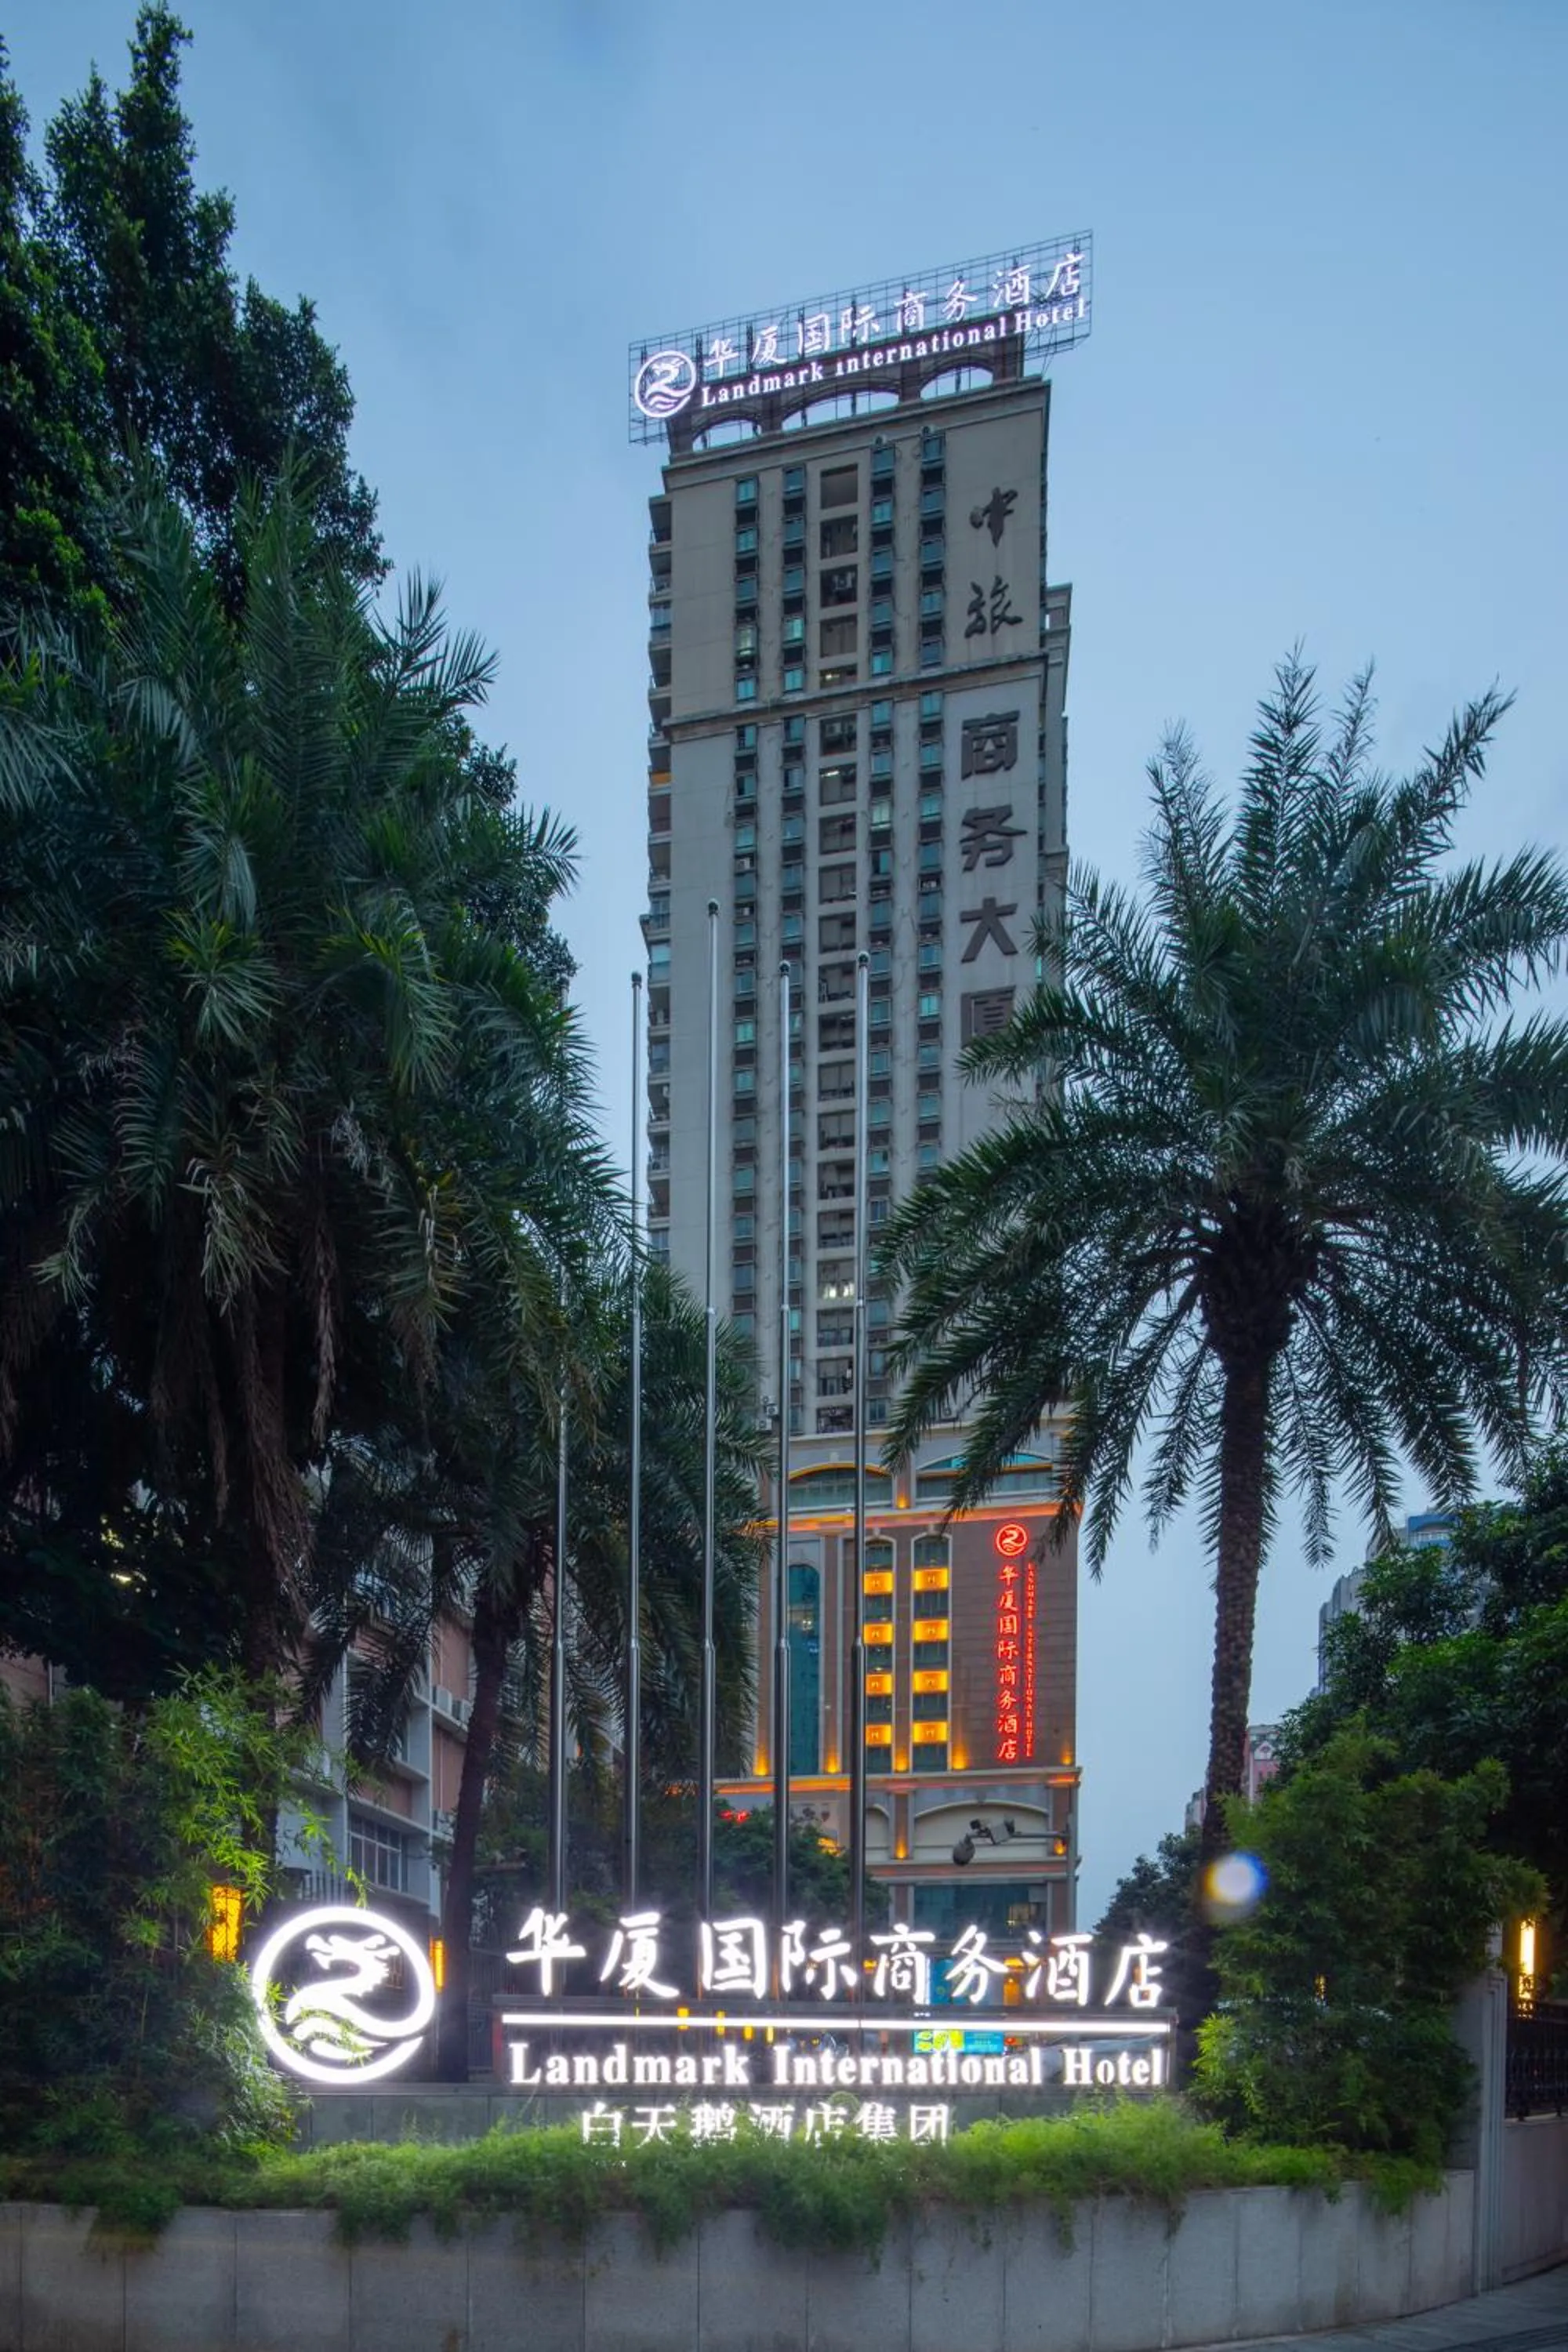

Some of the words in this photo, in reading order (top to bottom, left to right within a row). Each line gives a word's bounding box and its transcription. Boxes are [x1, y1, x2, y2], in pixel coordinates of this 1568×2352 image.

[702, 361, 823, 407] Landmark
[1014, 297, 1084, 334] Hotel
[704, 252, 1085, 378] 华厦国际商务酒店
[997, 1565, 1019, 1760] 华厦国际商务酒店
[506, 1907, 1169, 2008] 华厦国际商务酒店
[509, 2043, 750, 2085] Landmark
[773, 2045, 1041, 2085] International
[1063, 2048, 1162, 2085] Hotel
[581, 2100, 950, 2149] 白天鹅酒店集团
